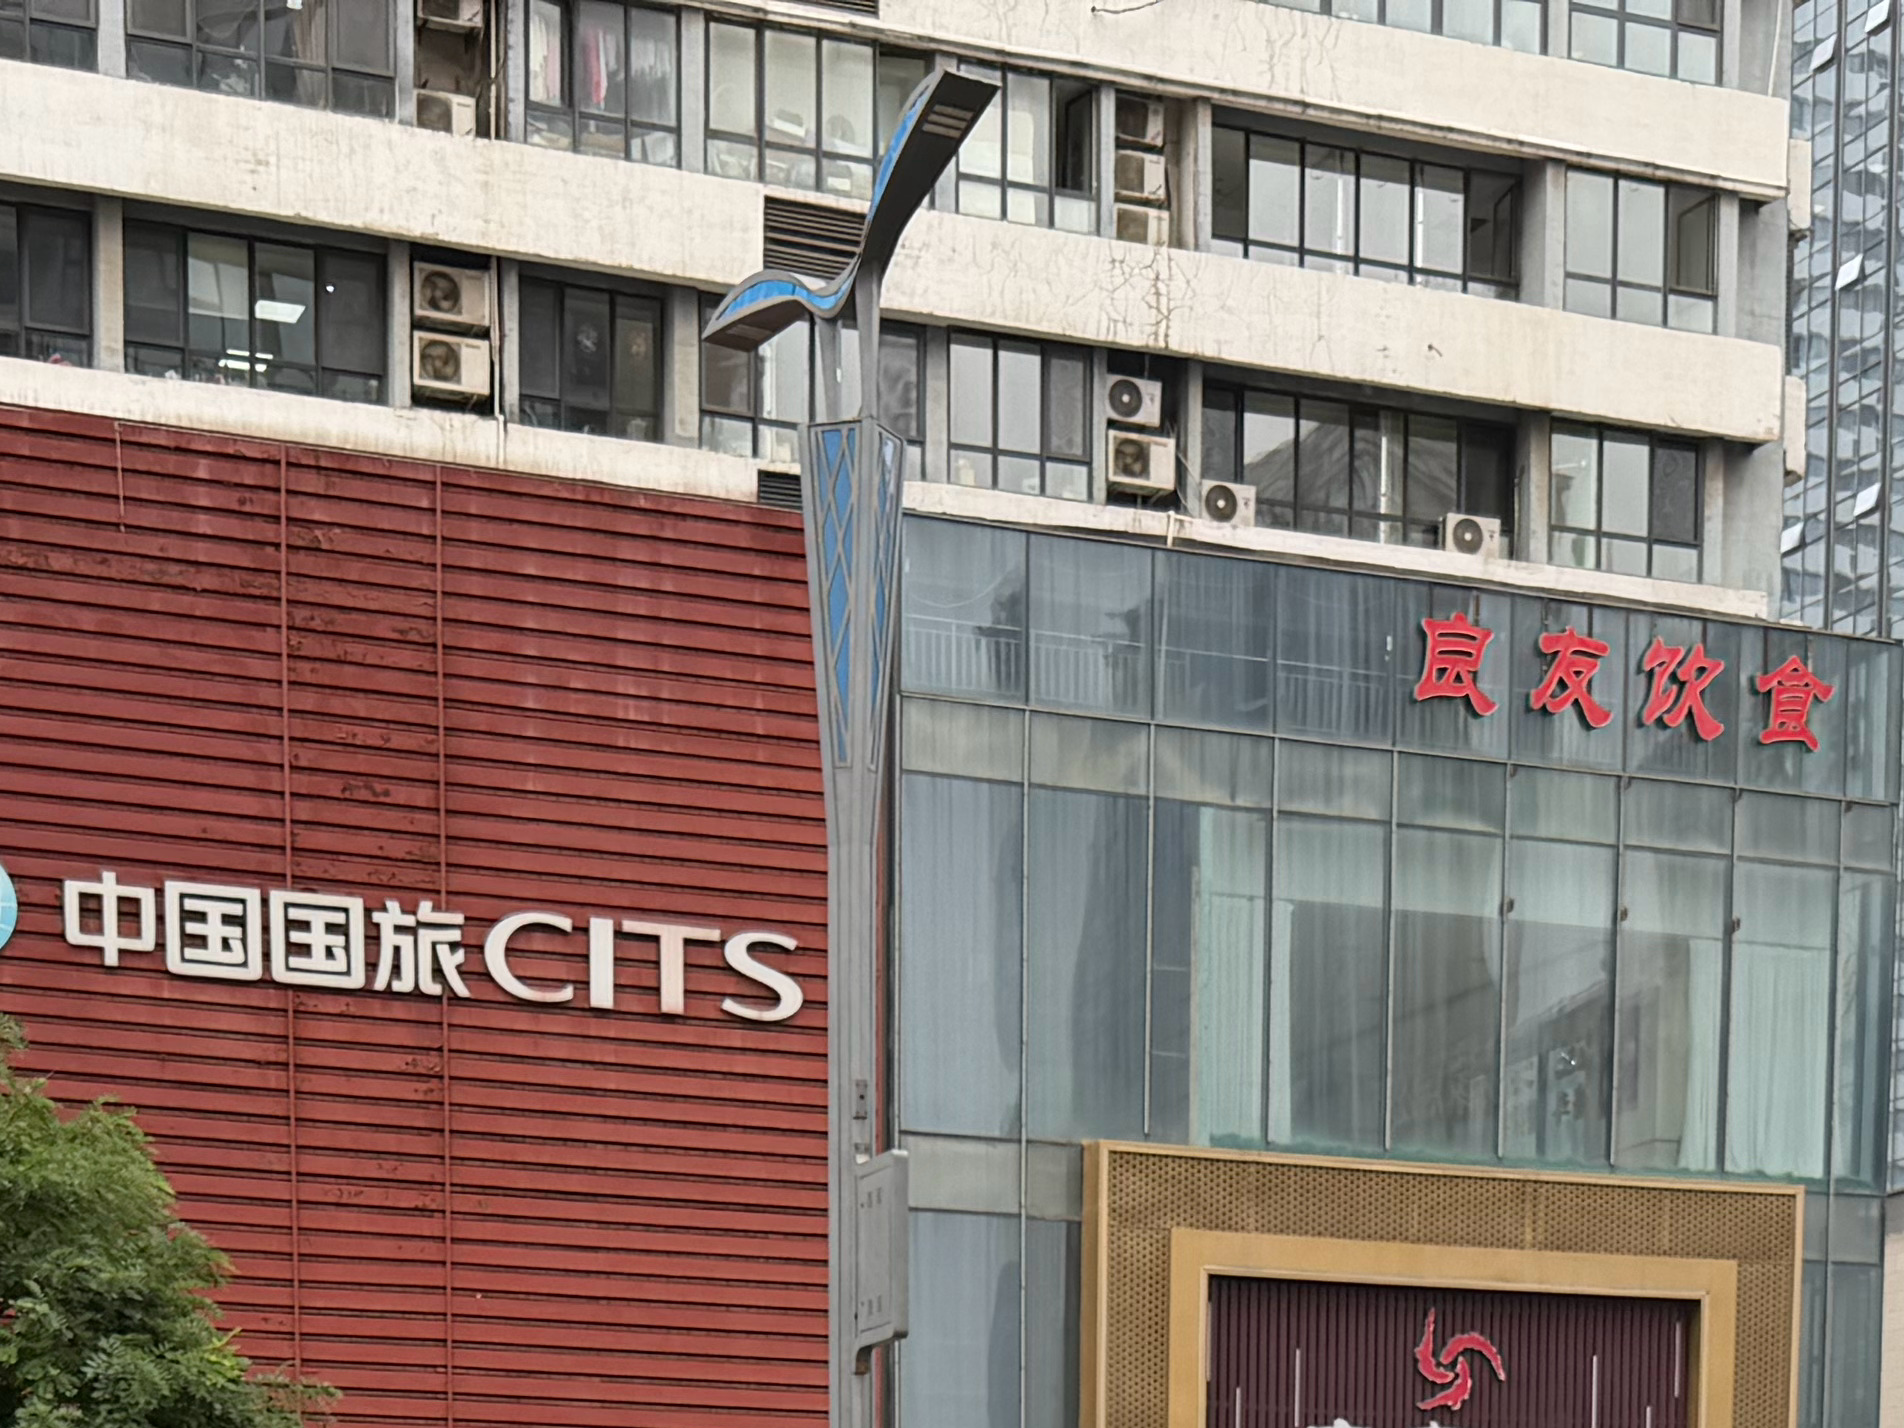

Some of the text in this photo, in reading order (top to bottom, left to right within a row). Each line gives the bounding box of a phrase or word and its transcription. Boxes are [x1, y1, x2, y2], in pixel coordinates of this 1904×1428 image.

[1414, 611, 1836, 753] 良友饮食
[62, 870, 804, 1022] 中国国旅CITS
